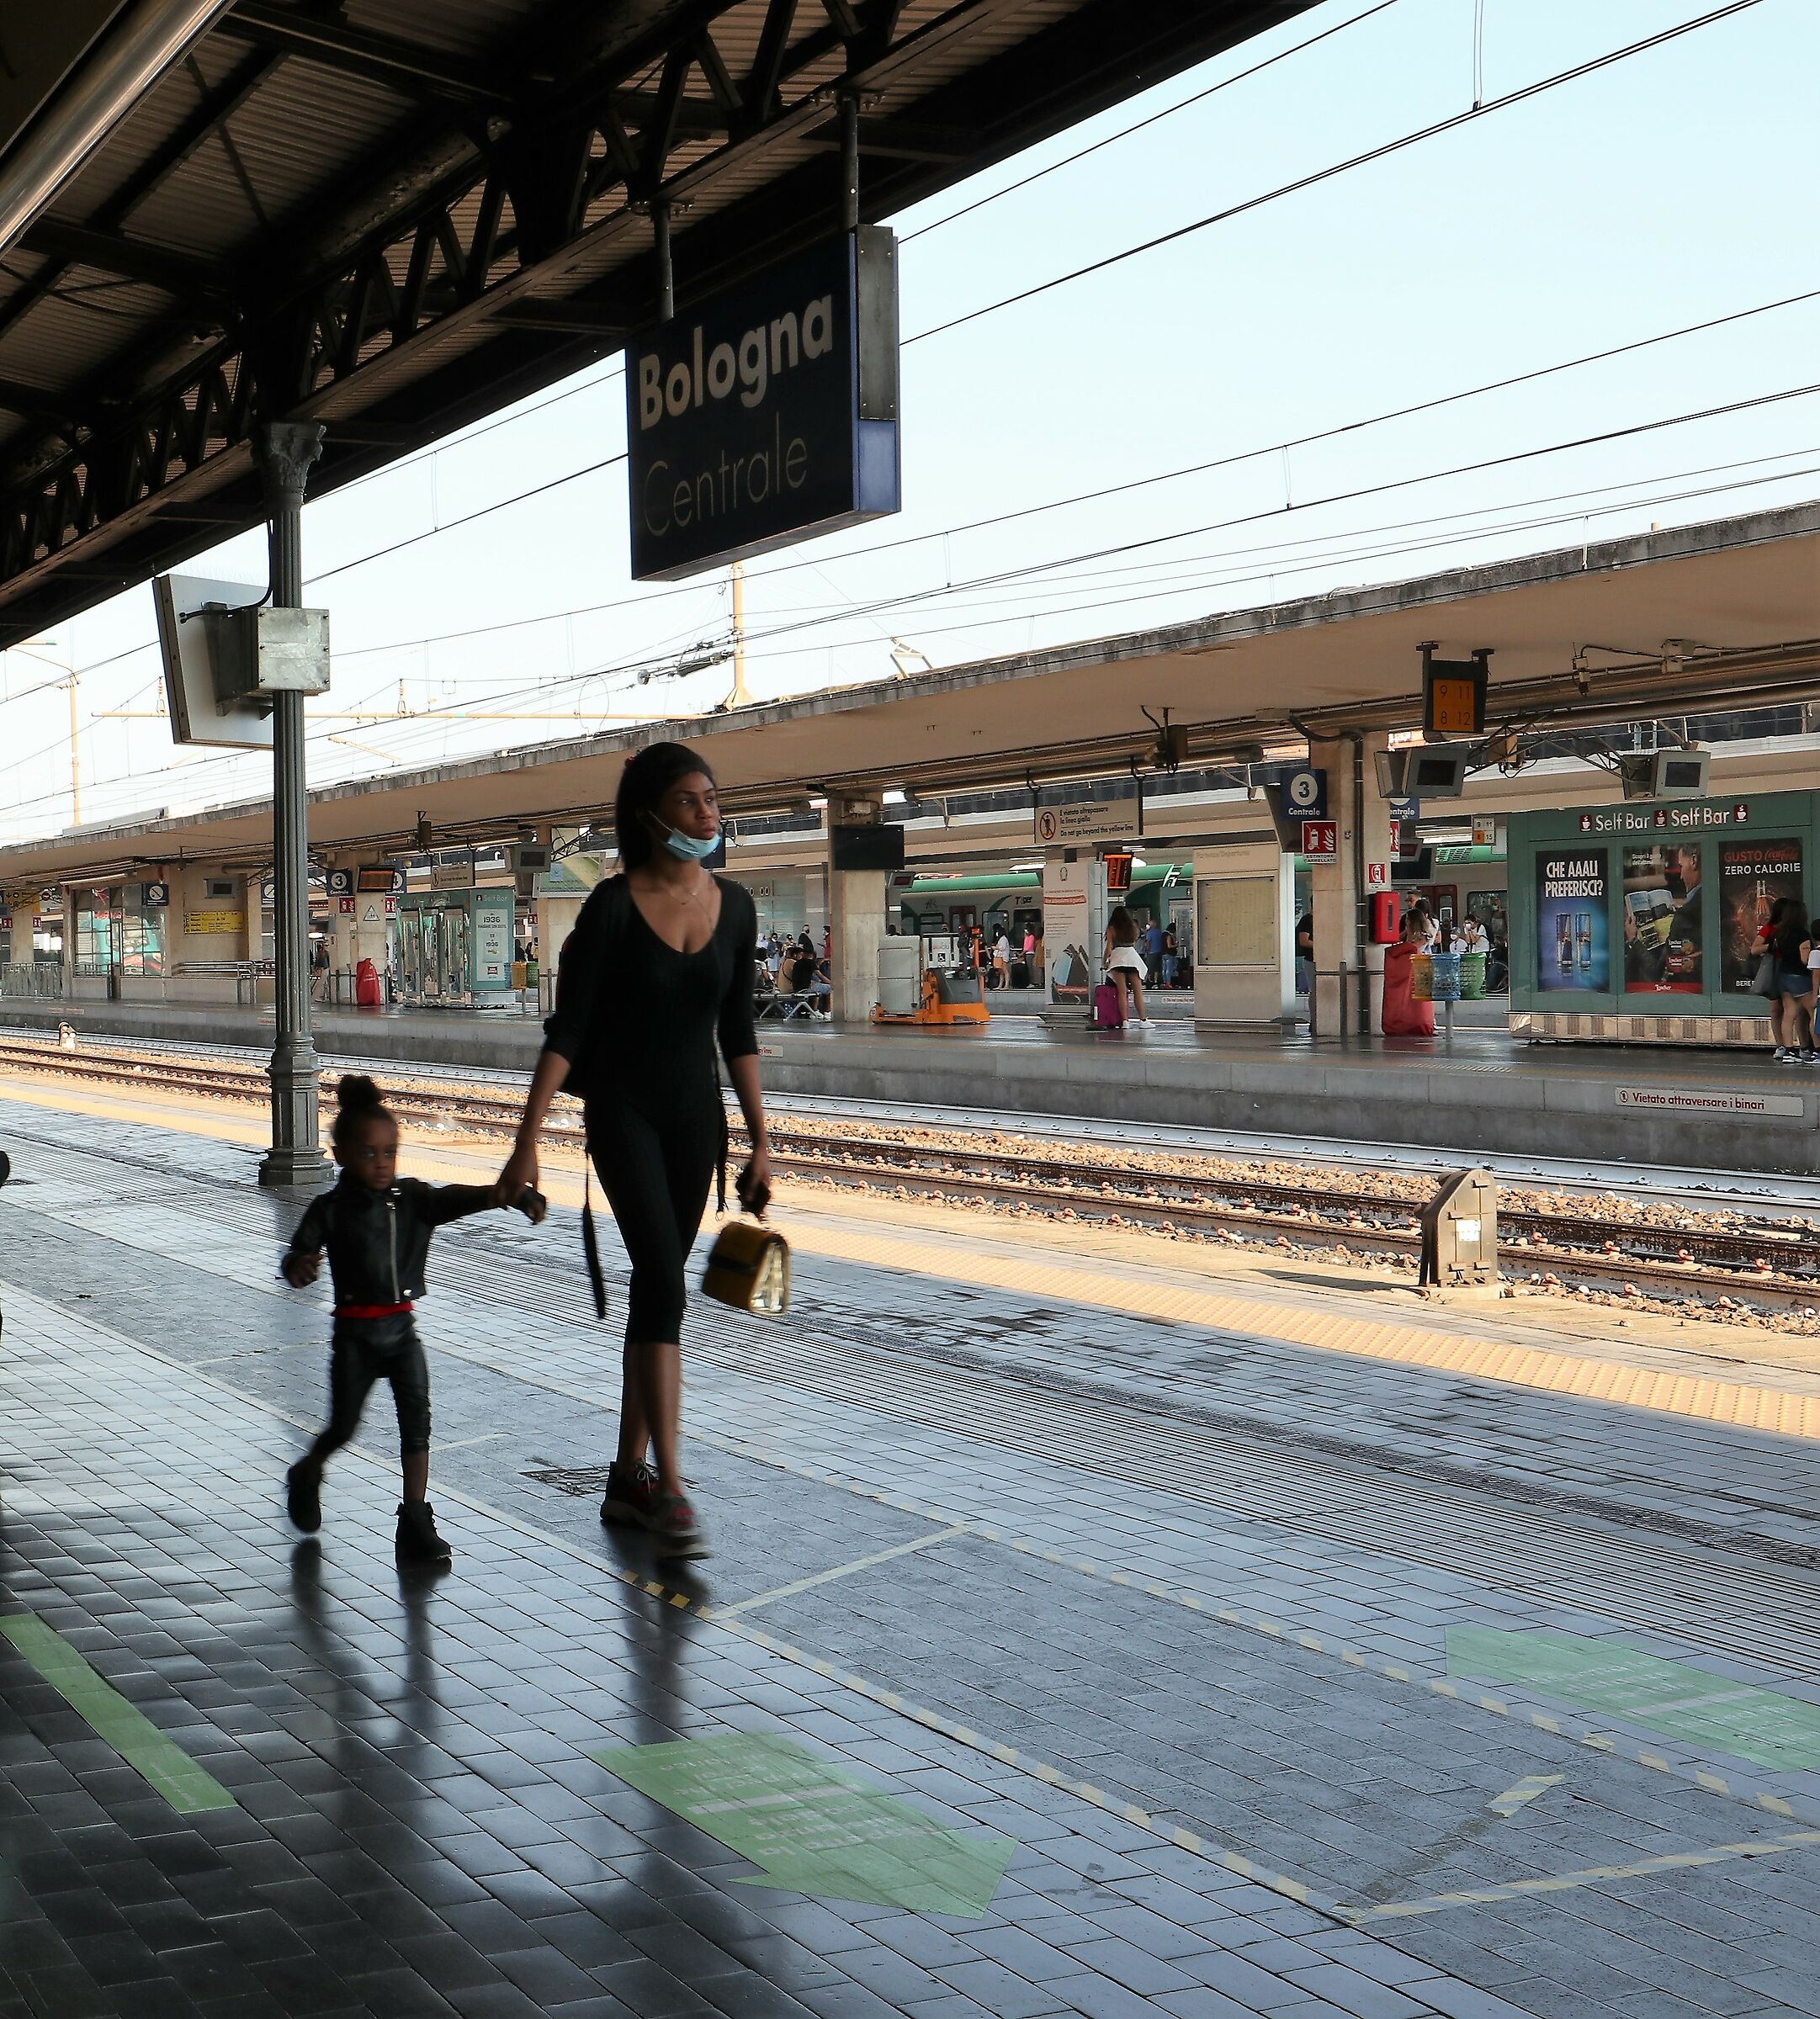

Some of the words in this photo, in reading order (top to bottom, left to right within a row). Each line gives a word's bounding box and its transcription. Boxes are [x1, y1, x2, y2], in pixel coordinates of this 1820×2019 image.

[639, 294, 833, 431] Bologna
[644, 411, 808, 537] Centrale
[1440, 685, 1448, 700] 9
[1458, 684, 1471, 700] 11
[1440, 711, 1448, 724] 8
[1457, 711, 1471, 725] 12
[1298, 780, 1309, 798] 3
[1287, 806, 1321, 816] Centrale
[1390, 807, 1415, 815] entrale
[1594, 814, 1622, 831] Self
[1626, 813, 1649, 829] Bar
[1670, 808, 1700, 827] Self
[1703, 808, 1730, 824] Bar
[1082, 826, 1100, 835] beyond
[1723, 851, 1763, 862] GUSTO
[1547, 861, 1565, 877] CHE
[1568, 860, 1598, 877] AAALI
[1724, 865, 1752, 876] ZERO
[1754, 862, 1801, 874] CALORIE
[335, 876, 342, 886] 3
[1545, 879, 1604, 898] PREFERISCI?
[1632, 1092, 1666, 1105] Vietato
[1668, 1094, 1728, 1108] attraversare
[1728, 1097, 1733, 1109] i
[1734, 1097, 1765, 1110] binari
